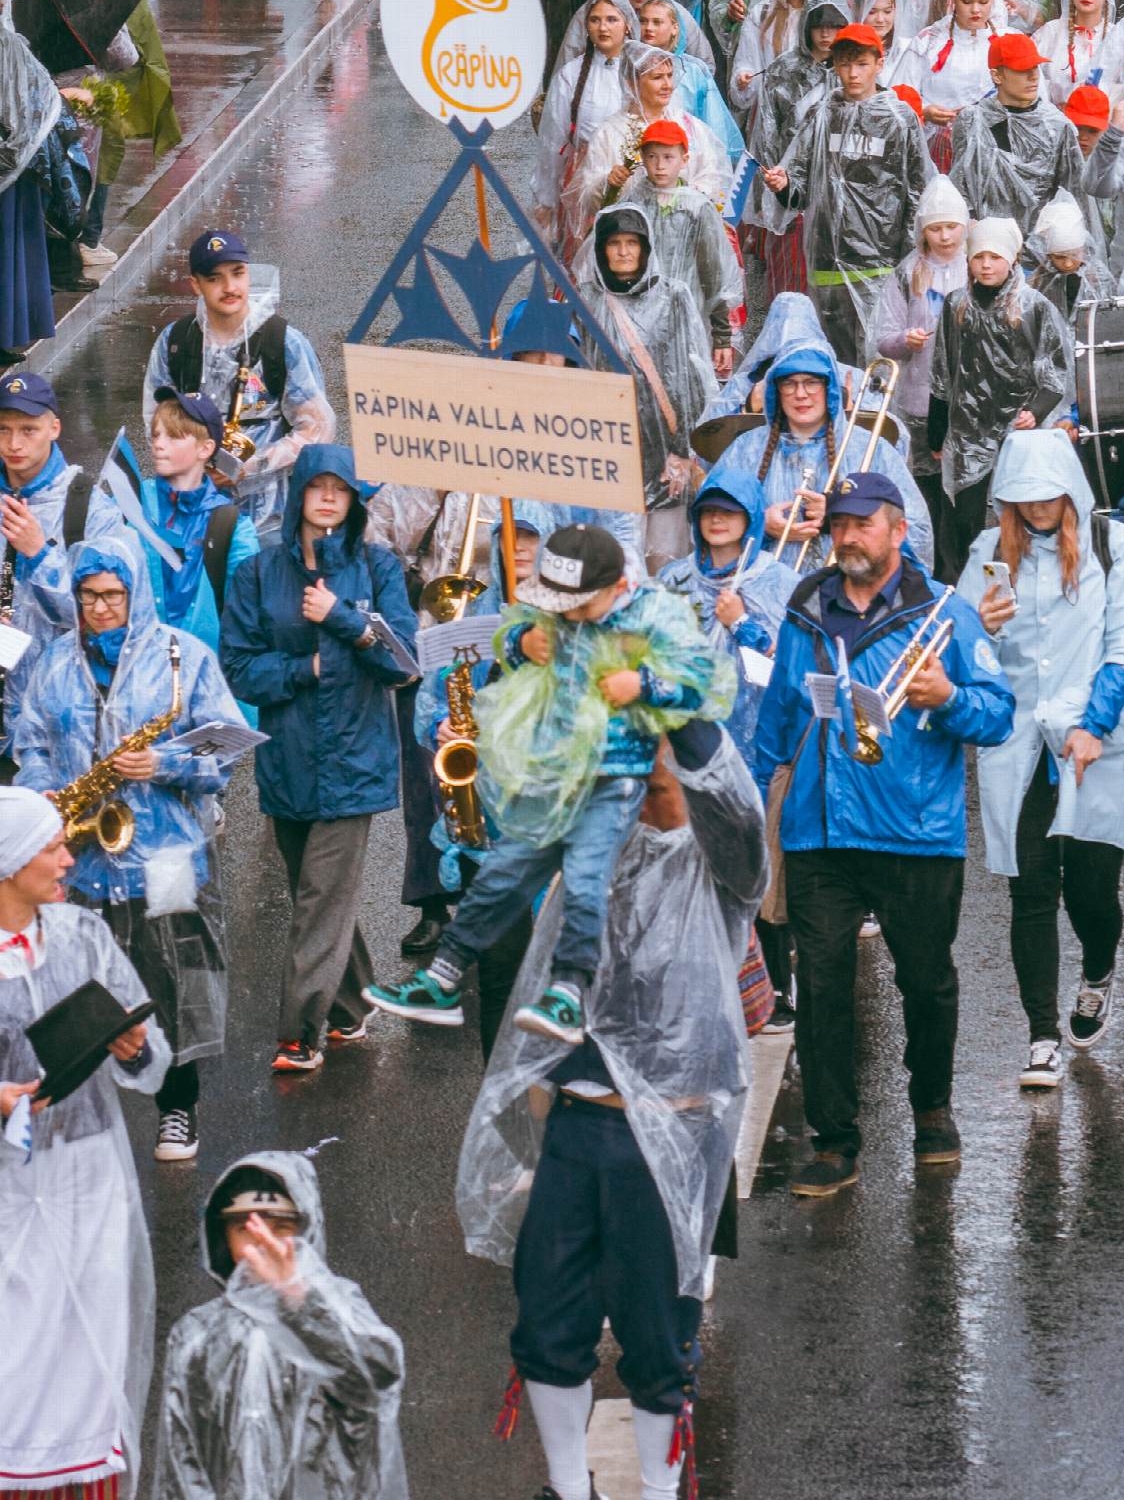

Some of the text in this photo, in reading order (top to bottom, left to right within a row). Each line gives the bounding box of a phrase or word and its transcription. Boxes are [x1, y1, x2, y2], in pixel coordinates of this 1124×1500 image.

[354, 388, 634, 446] RÄPINA VALLA NOORTE
[374, 432, 620, 484] PUHKPILLIORKESTER
